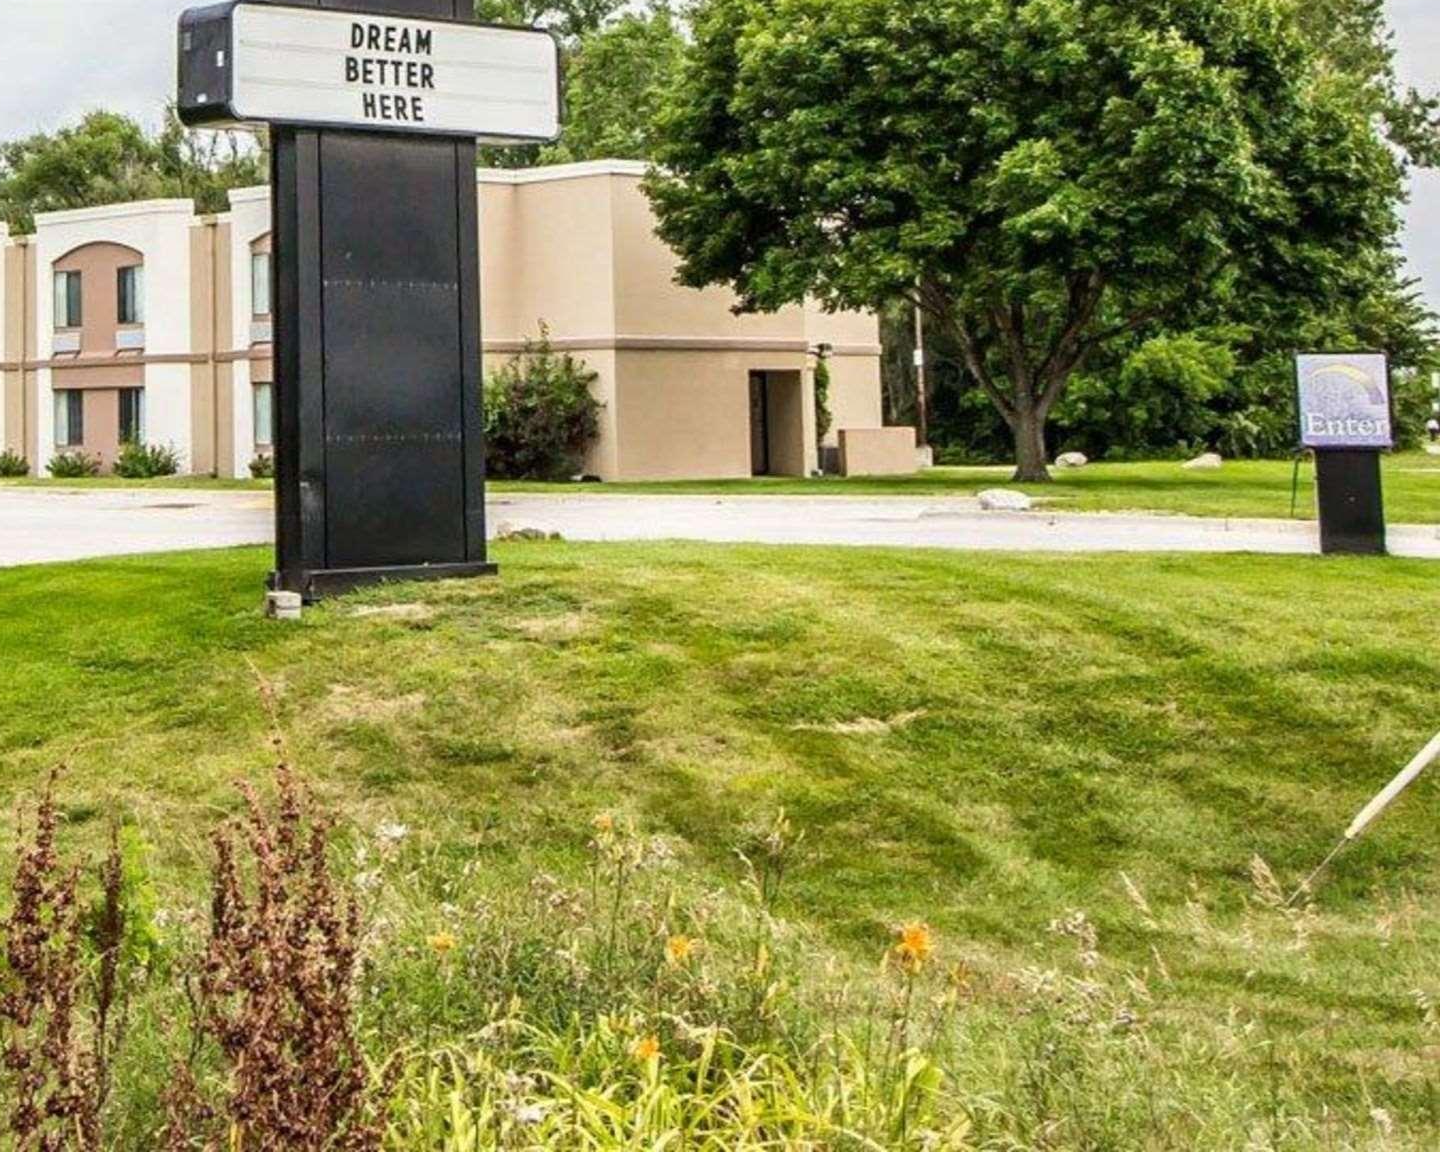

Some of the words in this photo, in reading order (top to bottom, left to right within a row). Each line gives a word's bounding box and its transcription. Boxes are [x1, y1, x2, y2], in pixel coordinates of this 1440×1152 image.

[351, 22, 432, 55] DREAM
[345, 57, 435, 88] BETTER
[363, 93, 424, 121] HERE
[1306, 412, 1387, 436] Enter
